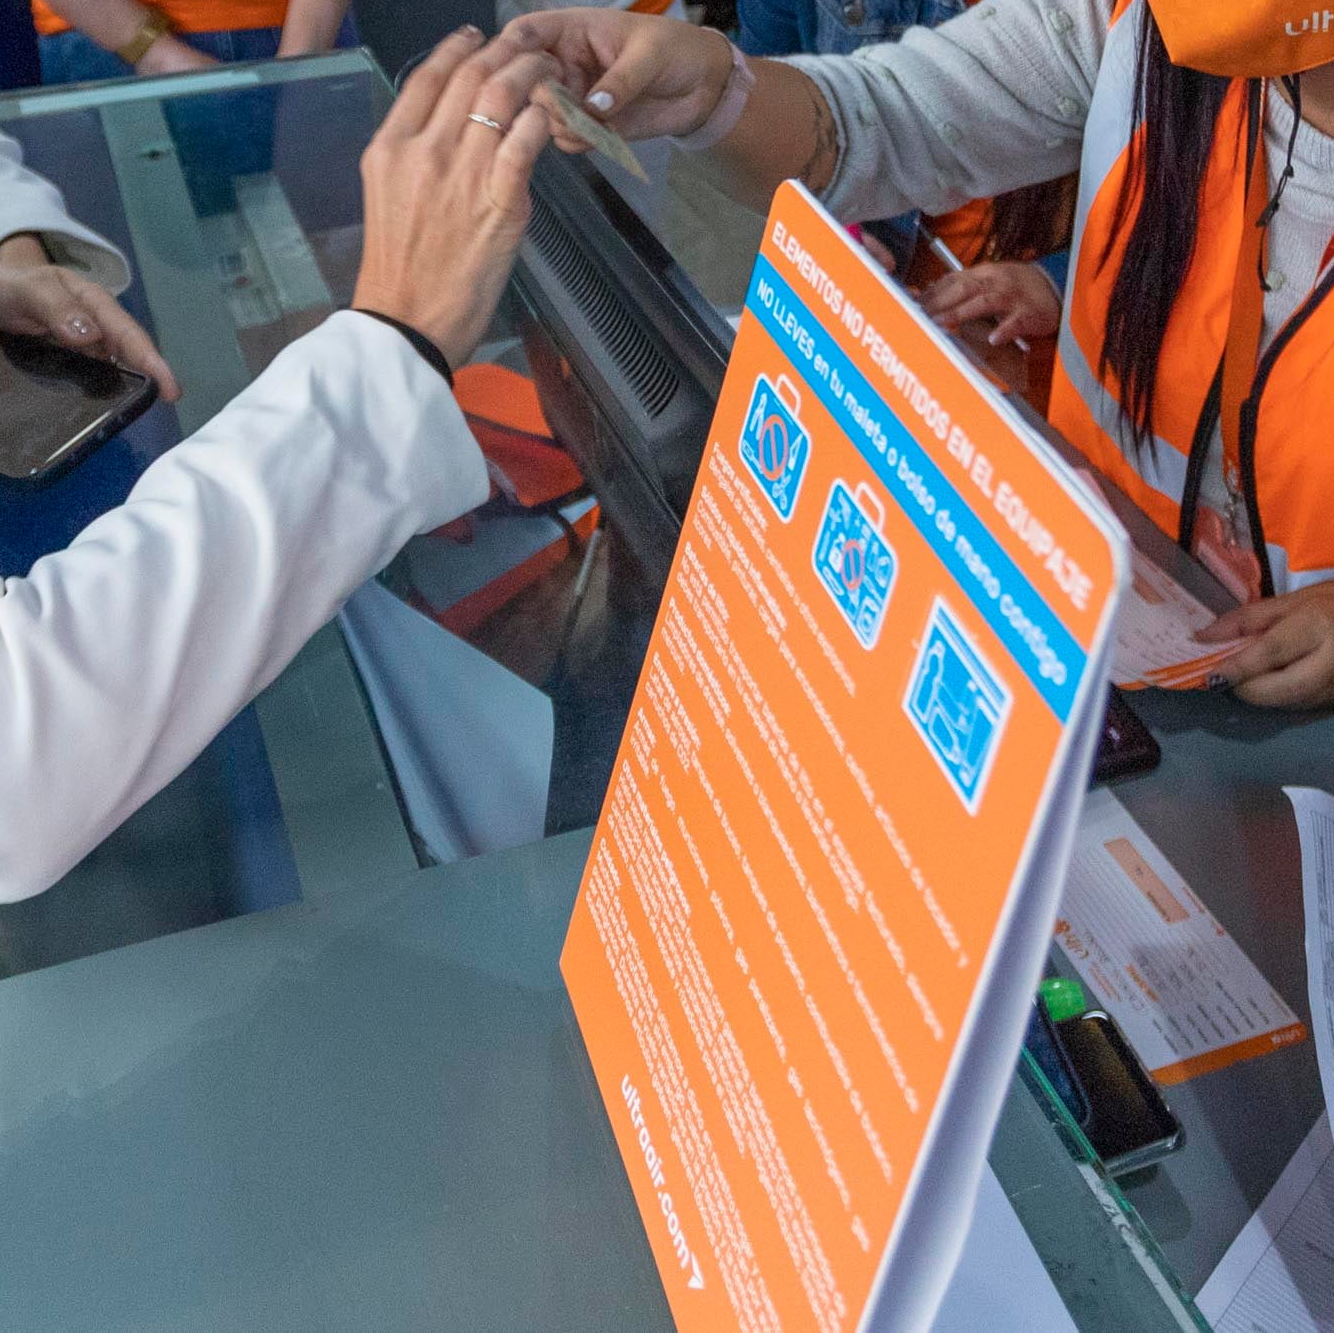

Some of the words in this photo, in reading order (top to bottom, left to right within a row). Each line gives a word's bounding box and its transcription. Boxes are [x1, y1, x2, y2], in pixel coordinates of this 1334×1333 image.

[757, 279, 774, 308] NO
[773, 299, 814, 359] LLEVES
[814, 354, 829, 379] en
[830, 369, 844, 398] tu
[844, 392, 887, 453] maleta
[887, 447, 897, 466] o
[897, 456, 935, 514] bolso
[935, 510, 956, 541] de
[955, 536, 1000, 598] mano
[1001, 594, 1066, 684] contigo
[773, 222, 843, 313] ELEMENTOS
[841, 302, 864, 337] NO
[862, 326, 949, 438] PERMITIDOS
[947, 426, 975, 468] EN
[970, 454, 1000, 501] EL
[995, 483, 1090, 607] EQUIPAJE
[619, 1073, 692, 1270] ultraair.com
